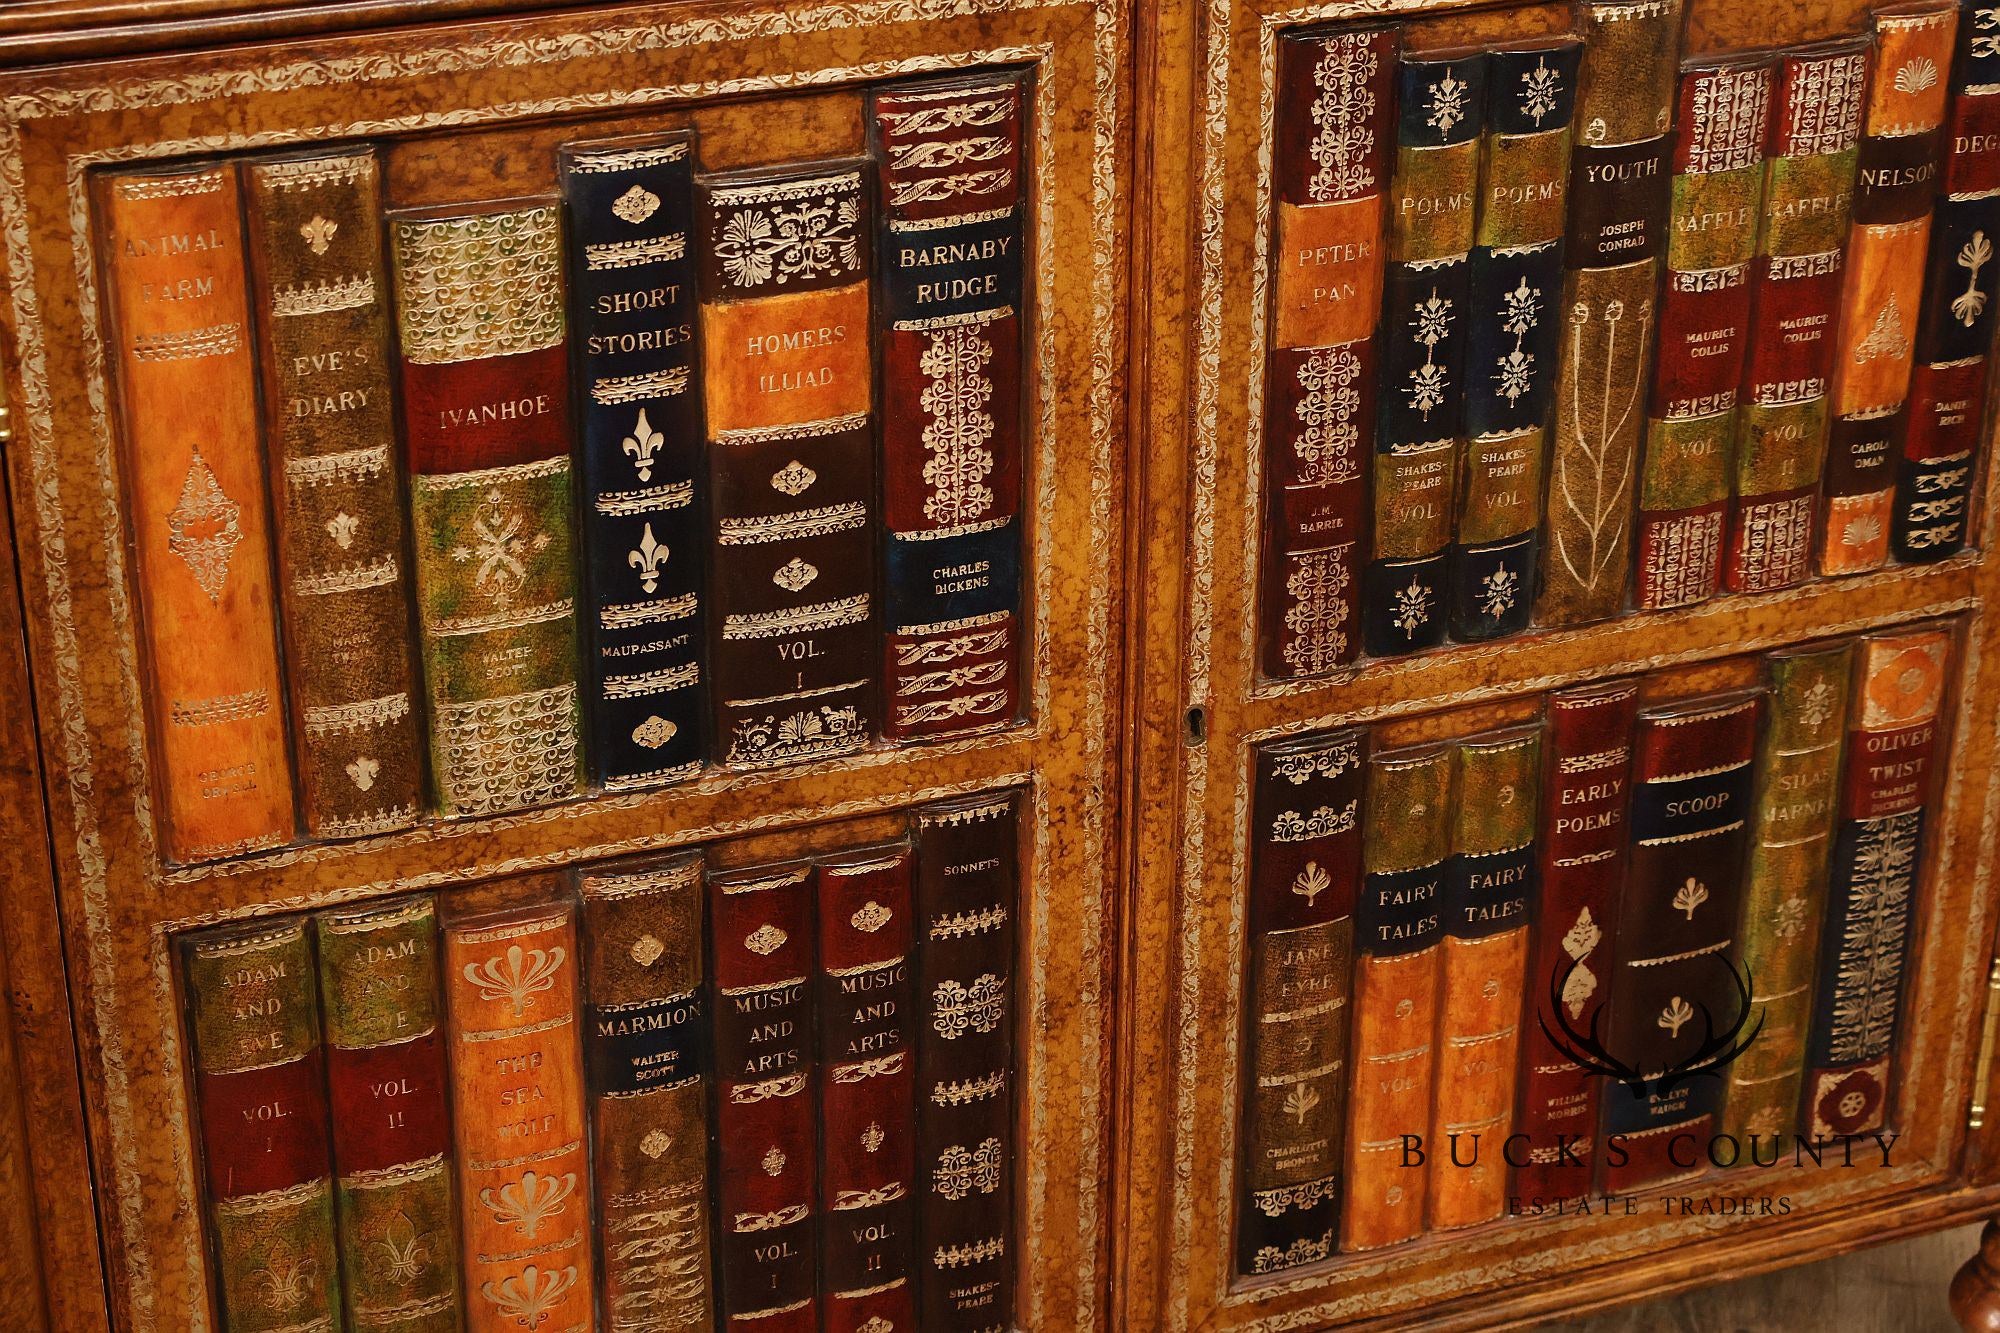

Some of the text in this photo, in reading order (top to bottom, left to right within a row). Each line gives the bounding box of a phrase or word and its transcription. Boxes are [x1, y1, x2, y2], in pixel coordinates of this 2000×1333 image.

[1585, 156, 1660, 185] YOUTH
[1860, 159, 1939, 187] NELSON
[1400, 190, 1474, 216] POEMS
[1493, 179, 1564, 204] POEMS
[1599, 219, 1645, 237] JOSEPH
[899, 238, 1011, 268] BARNABY
[1299, 240, 1371, 267] PETER
[1598, 234, 1645, 253] CONRAD
[142, 276, 214, 303] FARM
[598, 285, 681, 315] SHORT
[916, 275, 998, 304] RUDGE
[1313, 283, 1355, 305] PAN
[1779, 314, 1829, 330] MAURICE
[587, 325, 692, 356] STORIES
[746, 325, 848, 356] HOMERS
[1686, 326, 1737, 344] MAURICE
[1783, 330, 1822, 344] COLLIS
[293, 347, 370, 376] EVE'S
[1691, 343, 1730, 358] COLLIS
[759, 367, 834, 394] ILLIAD
[294, 386, 374, 417] DIARY
[439, 395, 551, 430] IVANHOE
[1938, 414, 1966, 427] RICH
[1488, 462, 1526, 478] PEARE
[1854, 455, 1885, 469] OMAN
[1300, 518, 1344, 534] BARRIE
[932, 560, 990, 580] CHARLES
[935, 576, 990, 595] DICKENS
[602, 633, 691, 657] MAUPASSANT
[777, 641, 826, 661] VOL.
[796, 672, 803, 689] I
[1867, 727, 1933, 753] OLIVER
[1779, 767, 1832, 791] SILAS
[1869, 757, 1926, 782] TWIST
[1561, 778, 1624, 806] EARLY
[1665, 791, 1730, 819] SCOOP
[1556, 808, 1622, 834] POEMS
[943, 857, 1000, 876] SONNETS
[1470, 864, 1528, 890] FAIRY
[1379, 880, 1439, 906] FAIRY
[1465, 898, 1525, 923] TALES
[1378, 914, 1439, 941] TALES
[353, 938, 417, 965] ADAM
[222, 961, 287, 990] ADAM
[839, 965, 906, 995] MUSIC
[233, 999, 283, 1021] AND
[735, 984, 804, 1014] MUSIC
[597, 1004, 701, 1038] MARMION
[852, 1001, 896, 1025] AND
[749, 1019, 795, 1043] AND
[846, 1029, 900, 1055] ARTS
[495, 1052, 543, 1075] THE
[631, 1049, 680, 1067] WALTER
[743, 1048, 799, 1075] ARTS
[635, 1064, 677, 1082] SCOTT
[370, 1078, 419, 1100] VOL.
[500, 1084, 545, 1106] SEA
[1547, 1091, 1589, 1107] WILLIAM
[242, 1100, 293, 1124] VOL.
[387, 1112, 405, 1129] II
[1547, 1104, 1588, 1121] MORRIS
[497, 1114, 556, 1138] WOLF
[852, 1225, 895, 1244] VOL.
[754, 1242, 798, 1264] VOL.
[867, 1253, 881, 1272] II
[949, 1281, 1000, 1299] SHAKES-
[957, 1294, 994, 1310] PEARE
